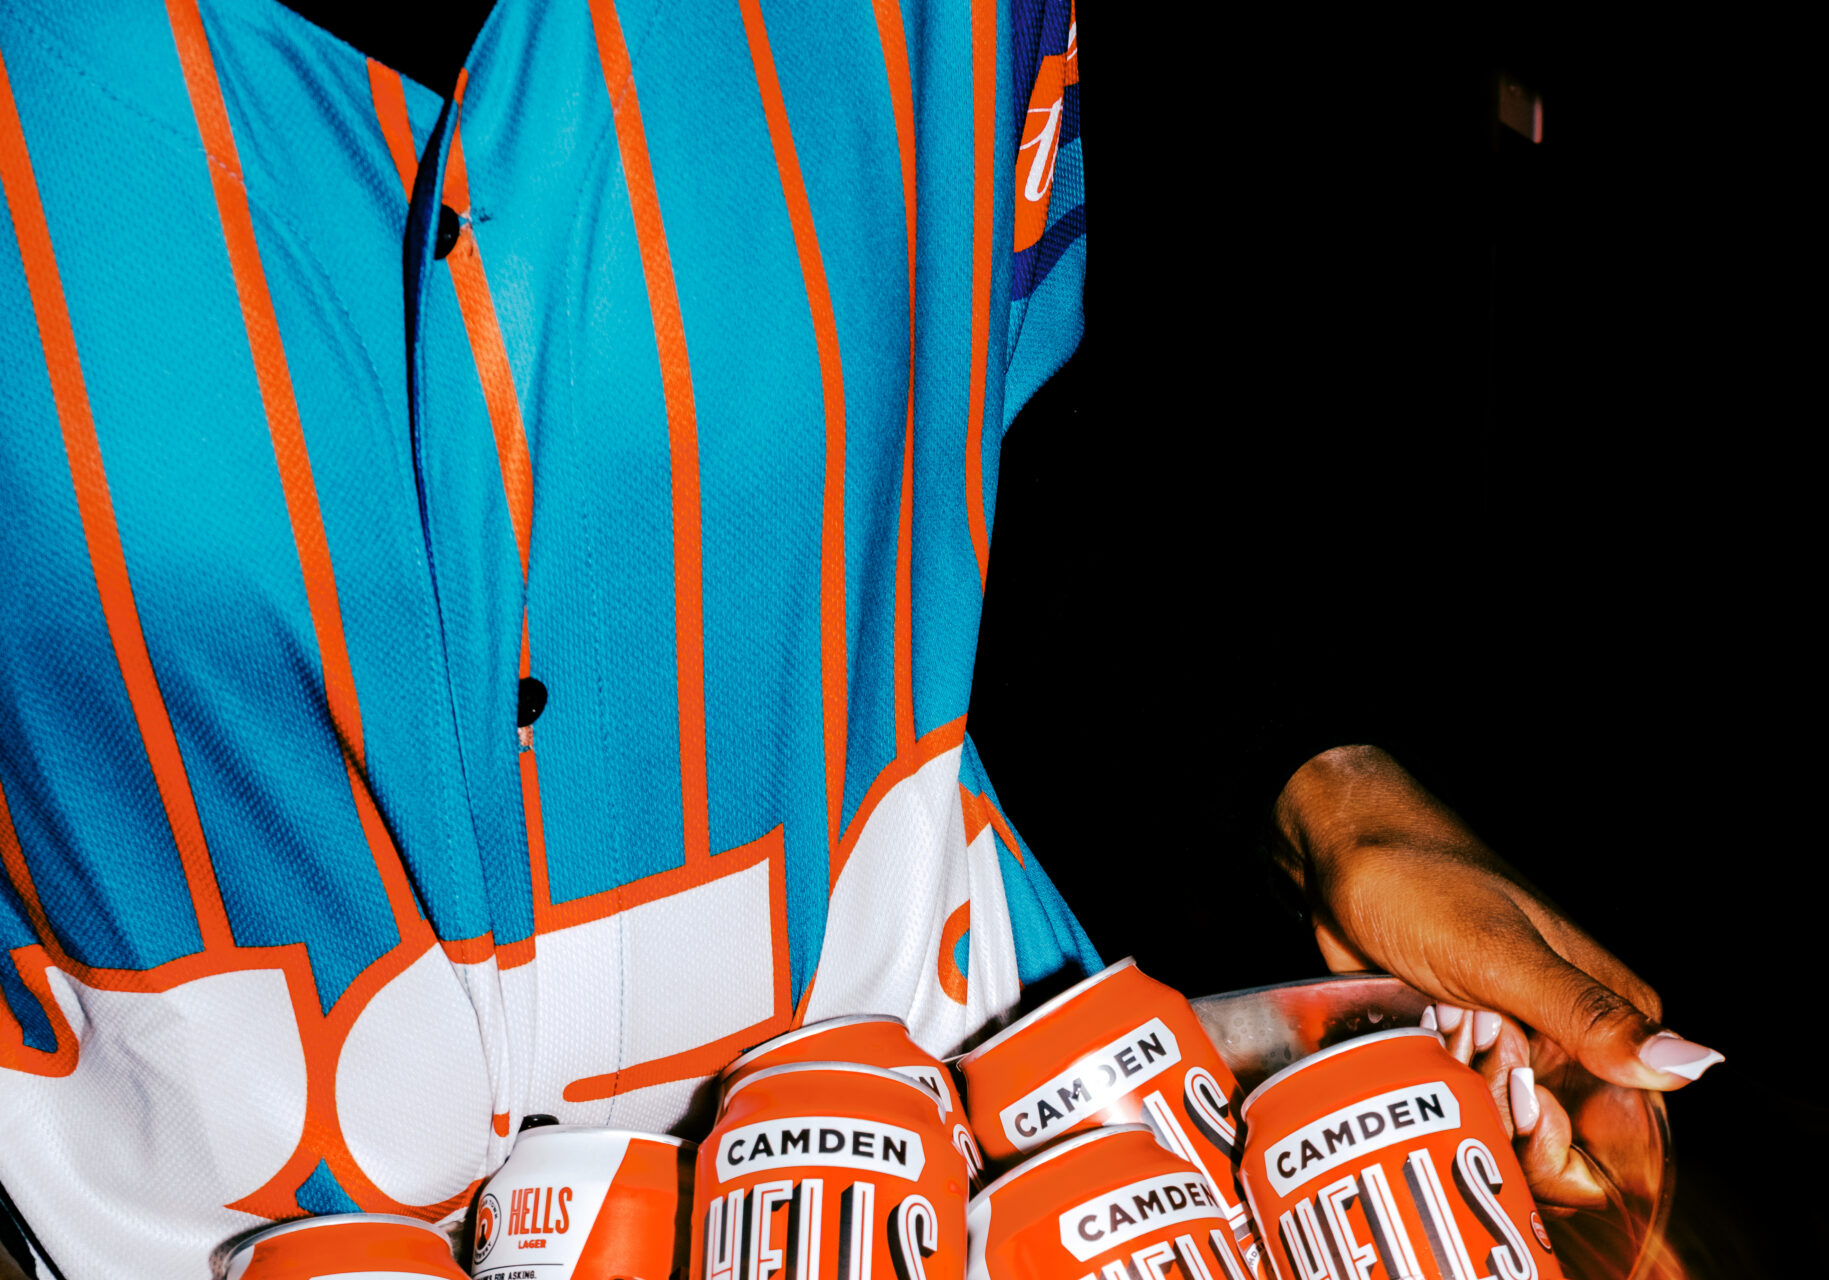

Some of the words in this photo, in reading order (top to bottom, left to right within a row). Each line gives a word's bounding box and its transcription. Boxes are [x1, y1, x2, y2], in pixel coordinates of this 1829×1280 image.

[727, 1127, 908, 1167] CAMDEN
[1276, 1093, 1446, 1180] CAMDEN
[508, 1186, 573, 1236] HELLS
[1077, 1182, 1221, 1243] CAMDEN
[518, 1239, 547, 1250] LAGER
[508, 1270, 537, 1280] ASKING.
